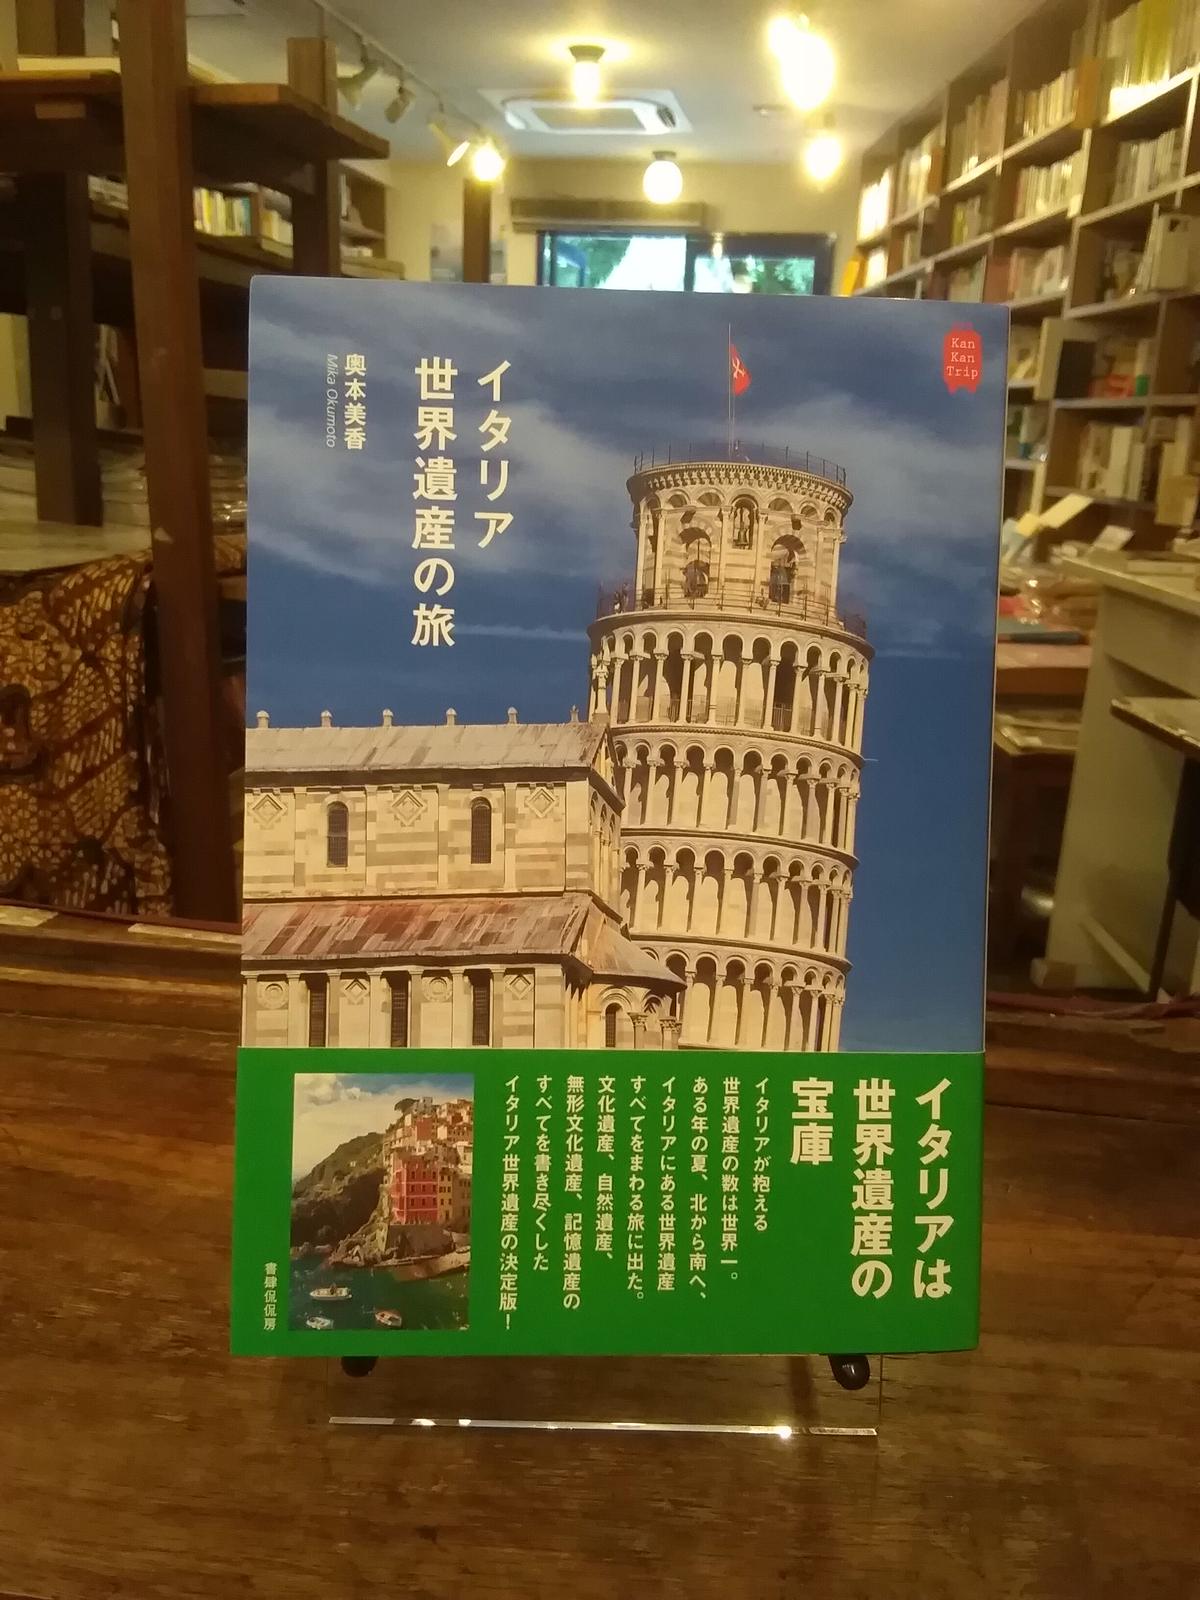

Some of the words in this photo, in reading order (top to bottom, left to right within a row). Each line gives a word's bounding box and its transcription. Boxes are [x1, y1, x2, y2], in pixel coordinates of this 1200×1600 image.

[326, 388, 338, 448] Okumoto
[327, 353, 338, 385] Mika
[344, 353, 367, 450] 奥本美香
[946, 365, 979, 380] Trip
[951, 337, 975, 349] Kan
[951, 351, 975, 363] Kan
[411, 356, 458, 647] 世界遺産の旅
[474, 360, 514, 549] イタリア
[498, 1075, 521, 1331] イタリア世界遺産の決定版！
[532, 1075, 553, 1272] すべてを書き尽くした
[562, 1075, 585, 1310] 無形文化遺産、記憶遺産の
[595, 1075, 616, 1260] 文化遺産、自然遺産、
[626, 1075, 647, 1300] すべてをまわる旅に出た。
[657, 1076, 677, 1291] イタリアにある世界遺産
[689, 1075, 709, 1299] ある年の夏、北から南へ、
[720, 1076, 741, 1281] 世界遺産の数は世界一。
[752, 1076, 771, 1232] イタリアが抱える
[790, 1077, 834, 1166] 宝庫
[850, 1077, 896, 1300] 世界遺産の
[913, 1077, 955, 1299] イタリアは
